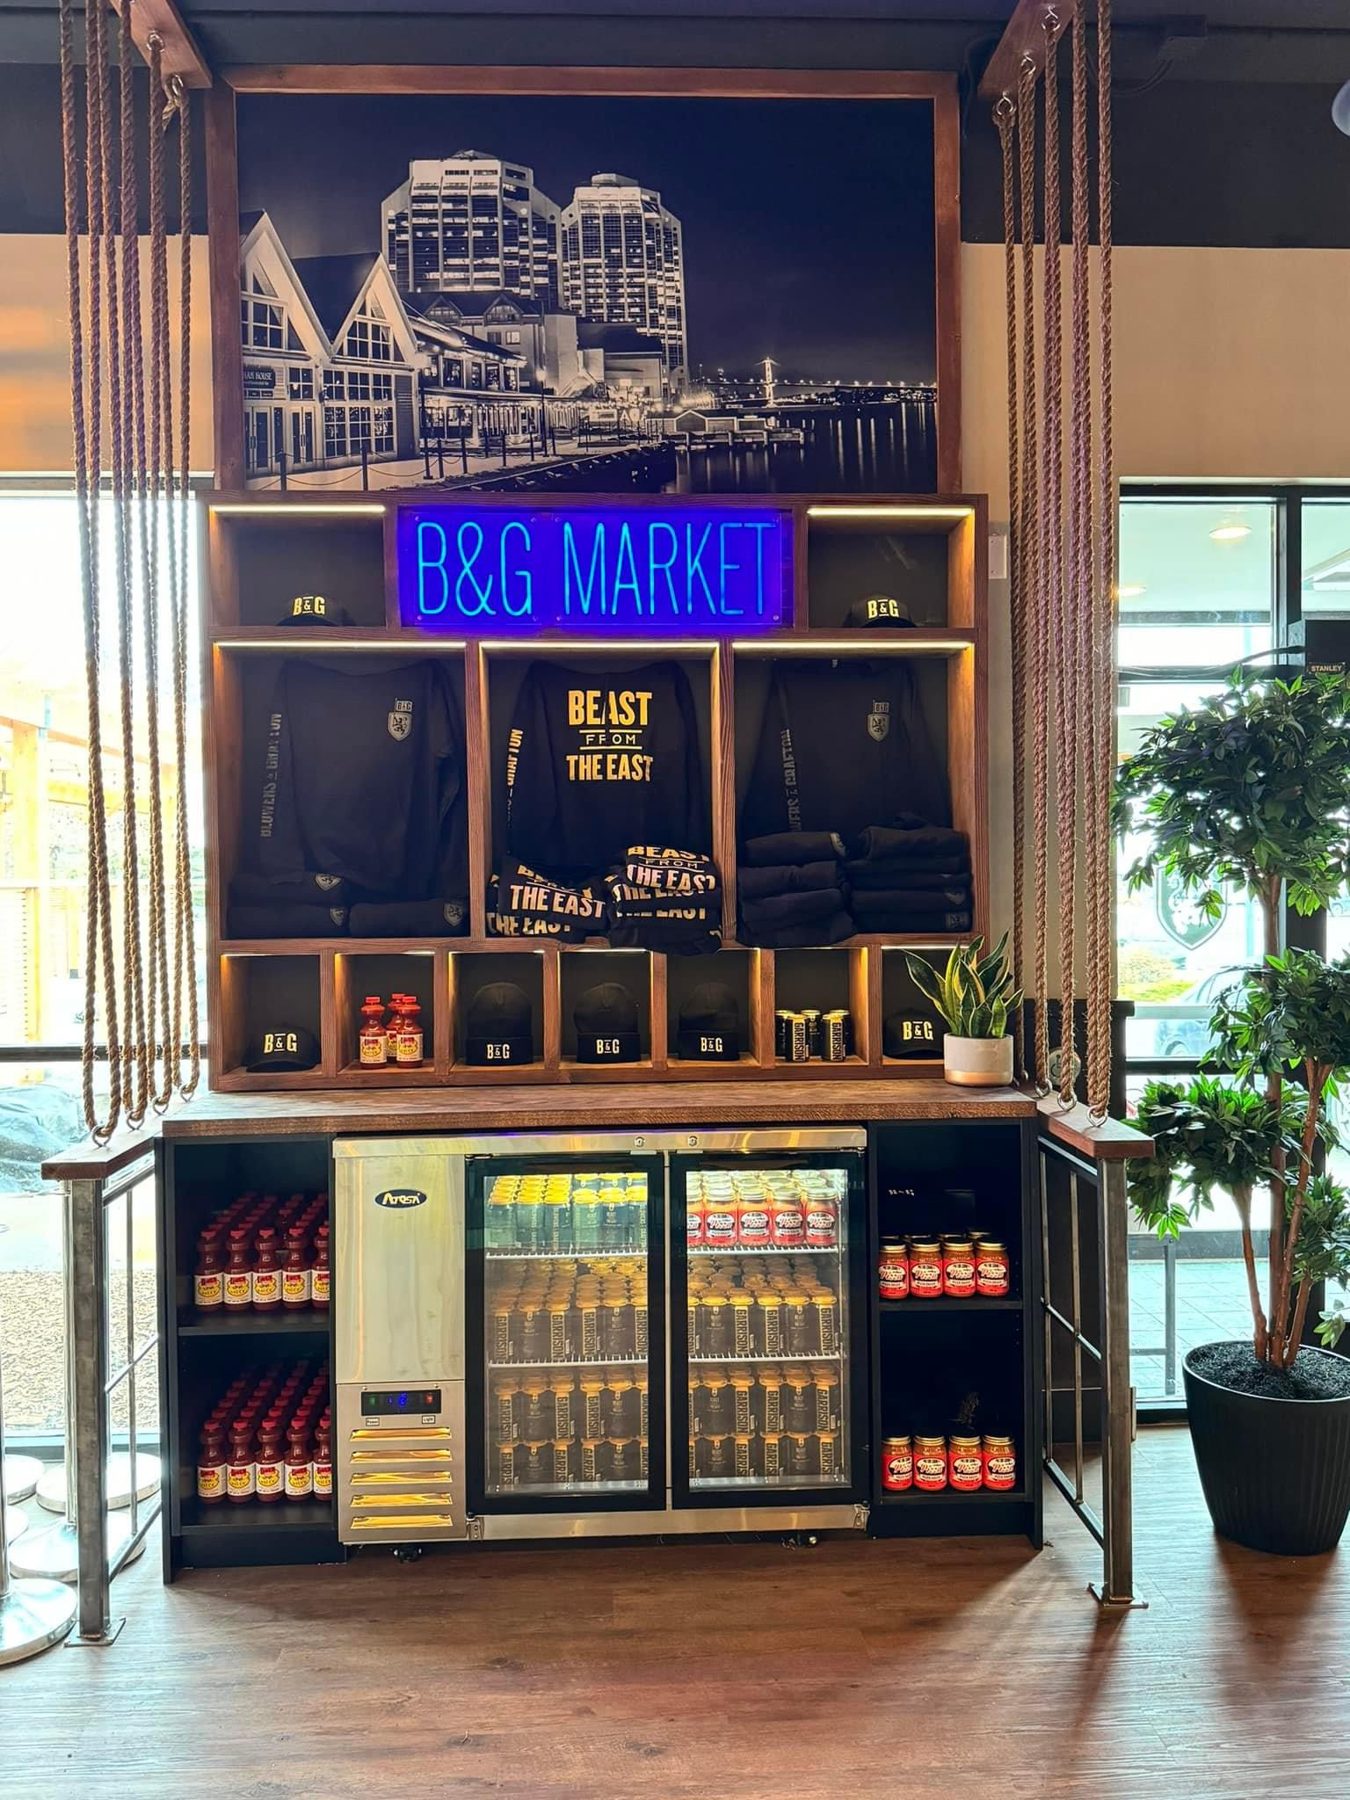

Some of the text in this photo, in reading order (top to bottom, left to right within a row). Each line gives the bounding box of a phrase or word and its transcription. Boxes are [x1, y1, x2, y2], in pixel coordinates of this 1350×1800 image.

[417, 521, 777, 616] B&G MARKET
[292, 596, 325, 616] B&G
[867, 599, 899, 619] B&G
[1311, 664, 1342, 672] STANLEY
[568, 689, 653, 726] BEAST
[566, 754, 654, 782] THE EAST
[627, 864, 663, 888] THE
[510, 884, 606, 918] THE EAST
[263, 1033, 298, 1054] B&G
[596, 1039, 620, 1054] B&G
[700, 1037, 723, 1052] B&G
[794, 1022, 804, 1061] GARRISON
[831, 1022, 842, 1061] GARRISON
[902, 1021, 934, 1040] B&G
[487, 1044, 510, 1059] B&G
[552, 1314, 564, 1359] GARRISON
[584, 1311, 596, 1357] GARRISON
[736, 1308, 749, 1353] GARRISON
[767, 1309, 779, 1353] GARRISON
[821, 1307, 834, 1352] GARRISON
[557, 1396, 570, 1439] GARRISON
[588, 1395, 600, 1440] GARRISON
[737, 1390, 749, 1434] GARRISON
[767, 1390, 779, 1433] GARRISON
[816, 1388, 829, 1432] GARRISON
